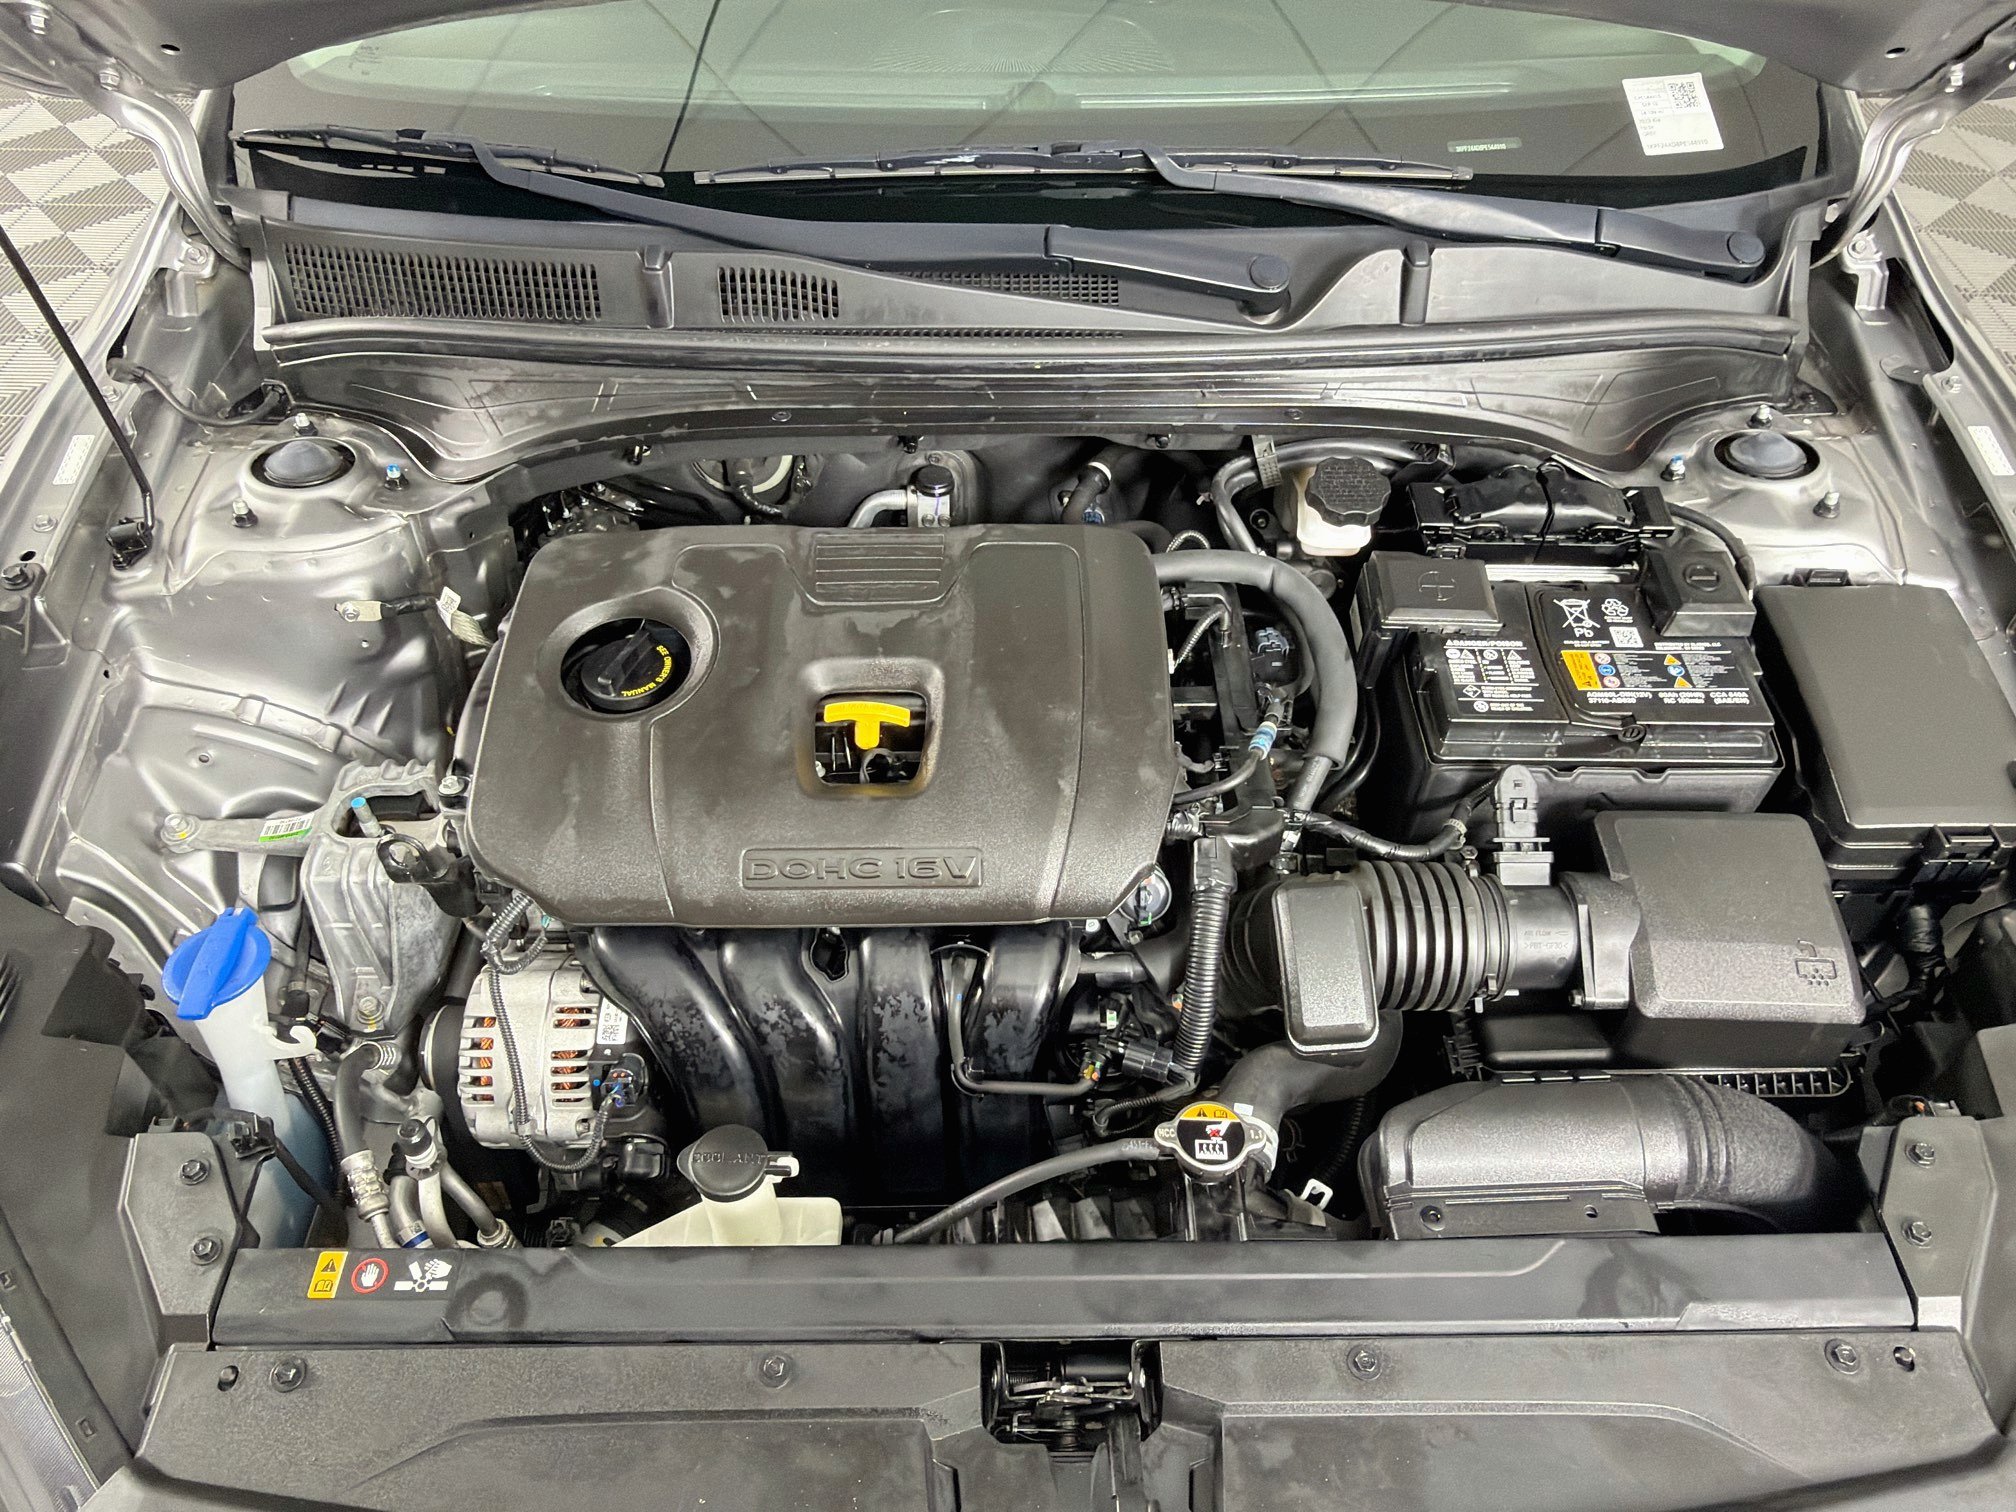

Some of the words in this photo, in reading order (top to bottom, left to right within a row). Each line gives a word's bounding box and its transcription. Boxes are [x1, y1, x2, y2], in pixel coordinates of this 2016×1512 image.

[1574, 627, 1594, 638] Pb
[656, 645, 669, 656] SEE
[621, 682, 657, 697] MANUAL
[745, 857, 882, 880] DOHC
[895, 856, 976, 879] 16V
[1249, 1129, 1263, 1139] 1.1
[692, 1152, 767, 1165] COOLANT
